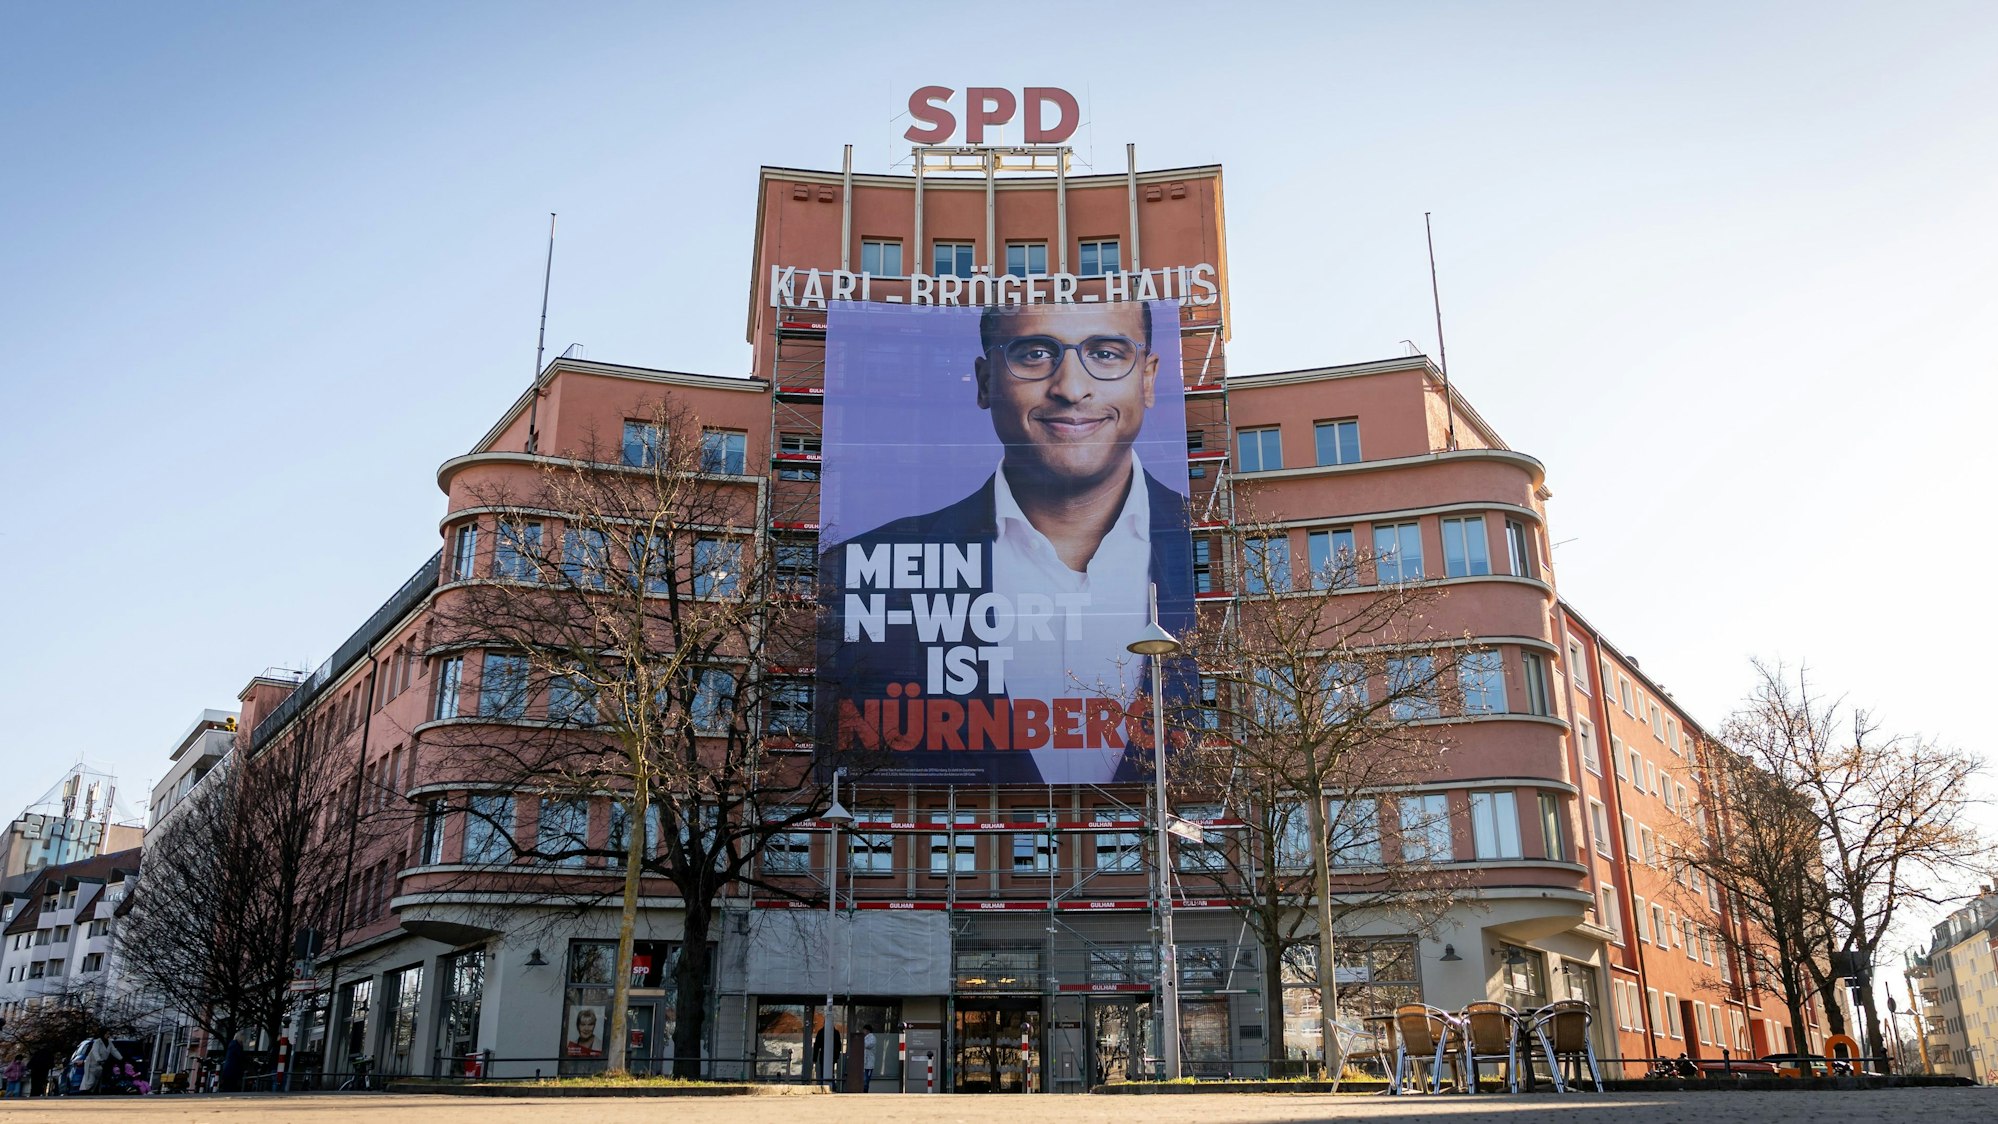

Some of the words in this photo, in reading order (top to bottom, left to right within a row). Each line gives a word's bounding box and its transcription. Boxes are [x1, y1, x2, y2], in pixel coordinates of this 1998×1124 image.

[903, 85, 1080, 145] SPD
[845, 543, 982, 589] MEIN
[844, 592, 1093, 643] N-WORT
[927, 645, 1014, 696] IST
[633, 966, 650, 974] SPD
